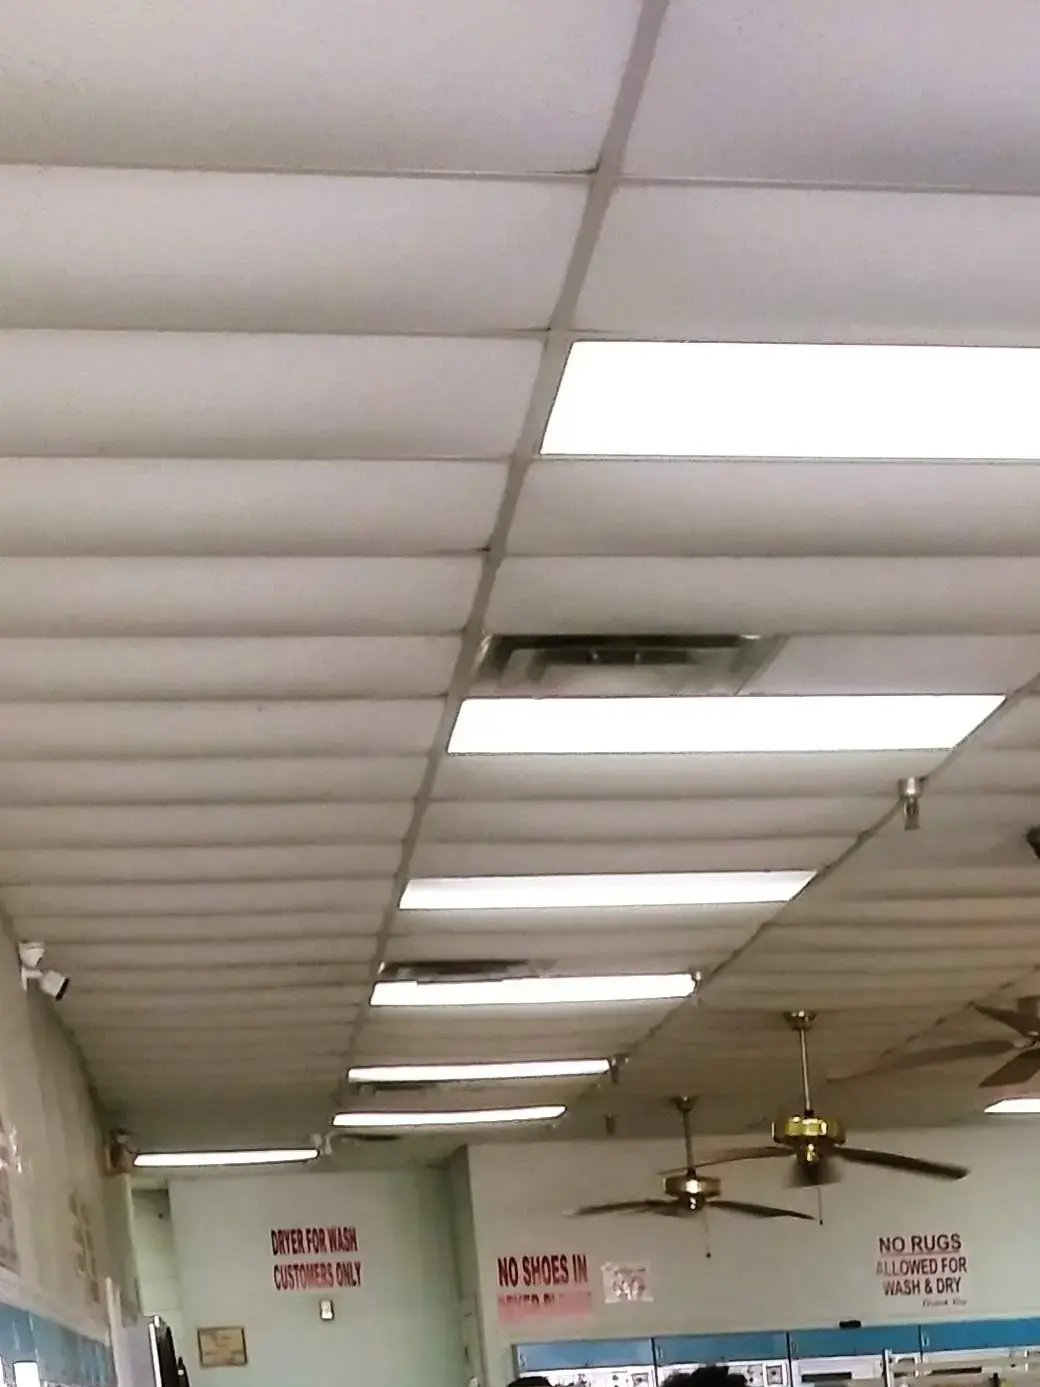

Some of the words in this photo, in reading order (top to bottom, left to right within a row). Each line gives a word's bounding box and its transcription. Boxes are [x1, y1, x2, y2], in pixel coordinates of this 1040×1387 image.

[271, 1228, 305, 1255] DRYER
[306, 1227, 326, 1253] FOR
[327, 1226, 358, 1252] WASH
[879, 1236, 905, 1253] NO
[911, 1233, 962, 1253] RUGS
[273, 1262, 335, 1290] CUSTOMERS
[336, 1260, 361, 1287] ONLY
[497, 1256, 519, 1287] NO
[522, 1253, 570, 1287] SHOES
[572, 1252, 589, 1283] IN
[876, 1258, 938, 1276] ALLOWED
[941, 1256, 967, 1274] FOR
[883, 1278, 921, 1296] WASH
[924, 1278, 933, 1295] &
[936, 1276, 961, 1294] DRY
